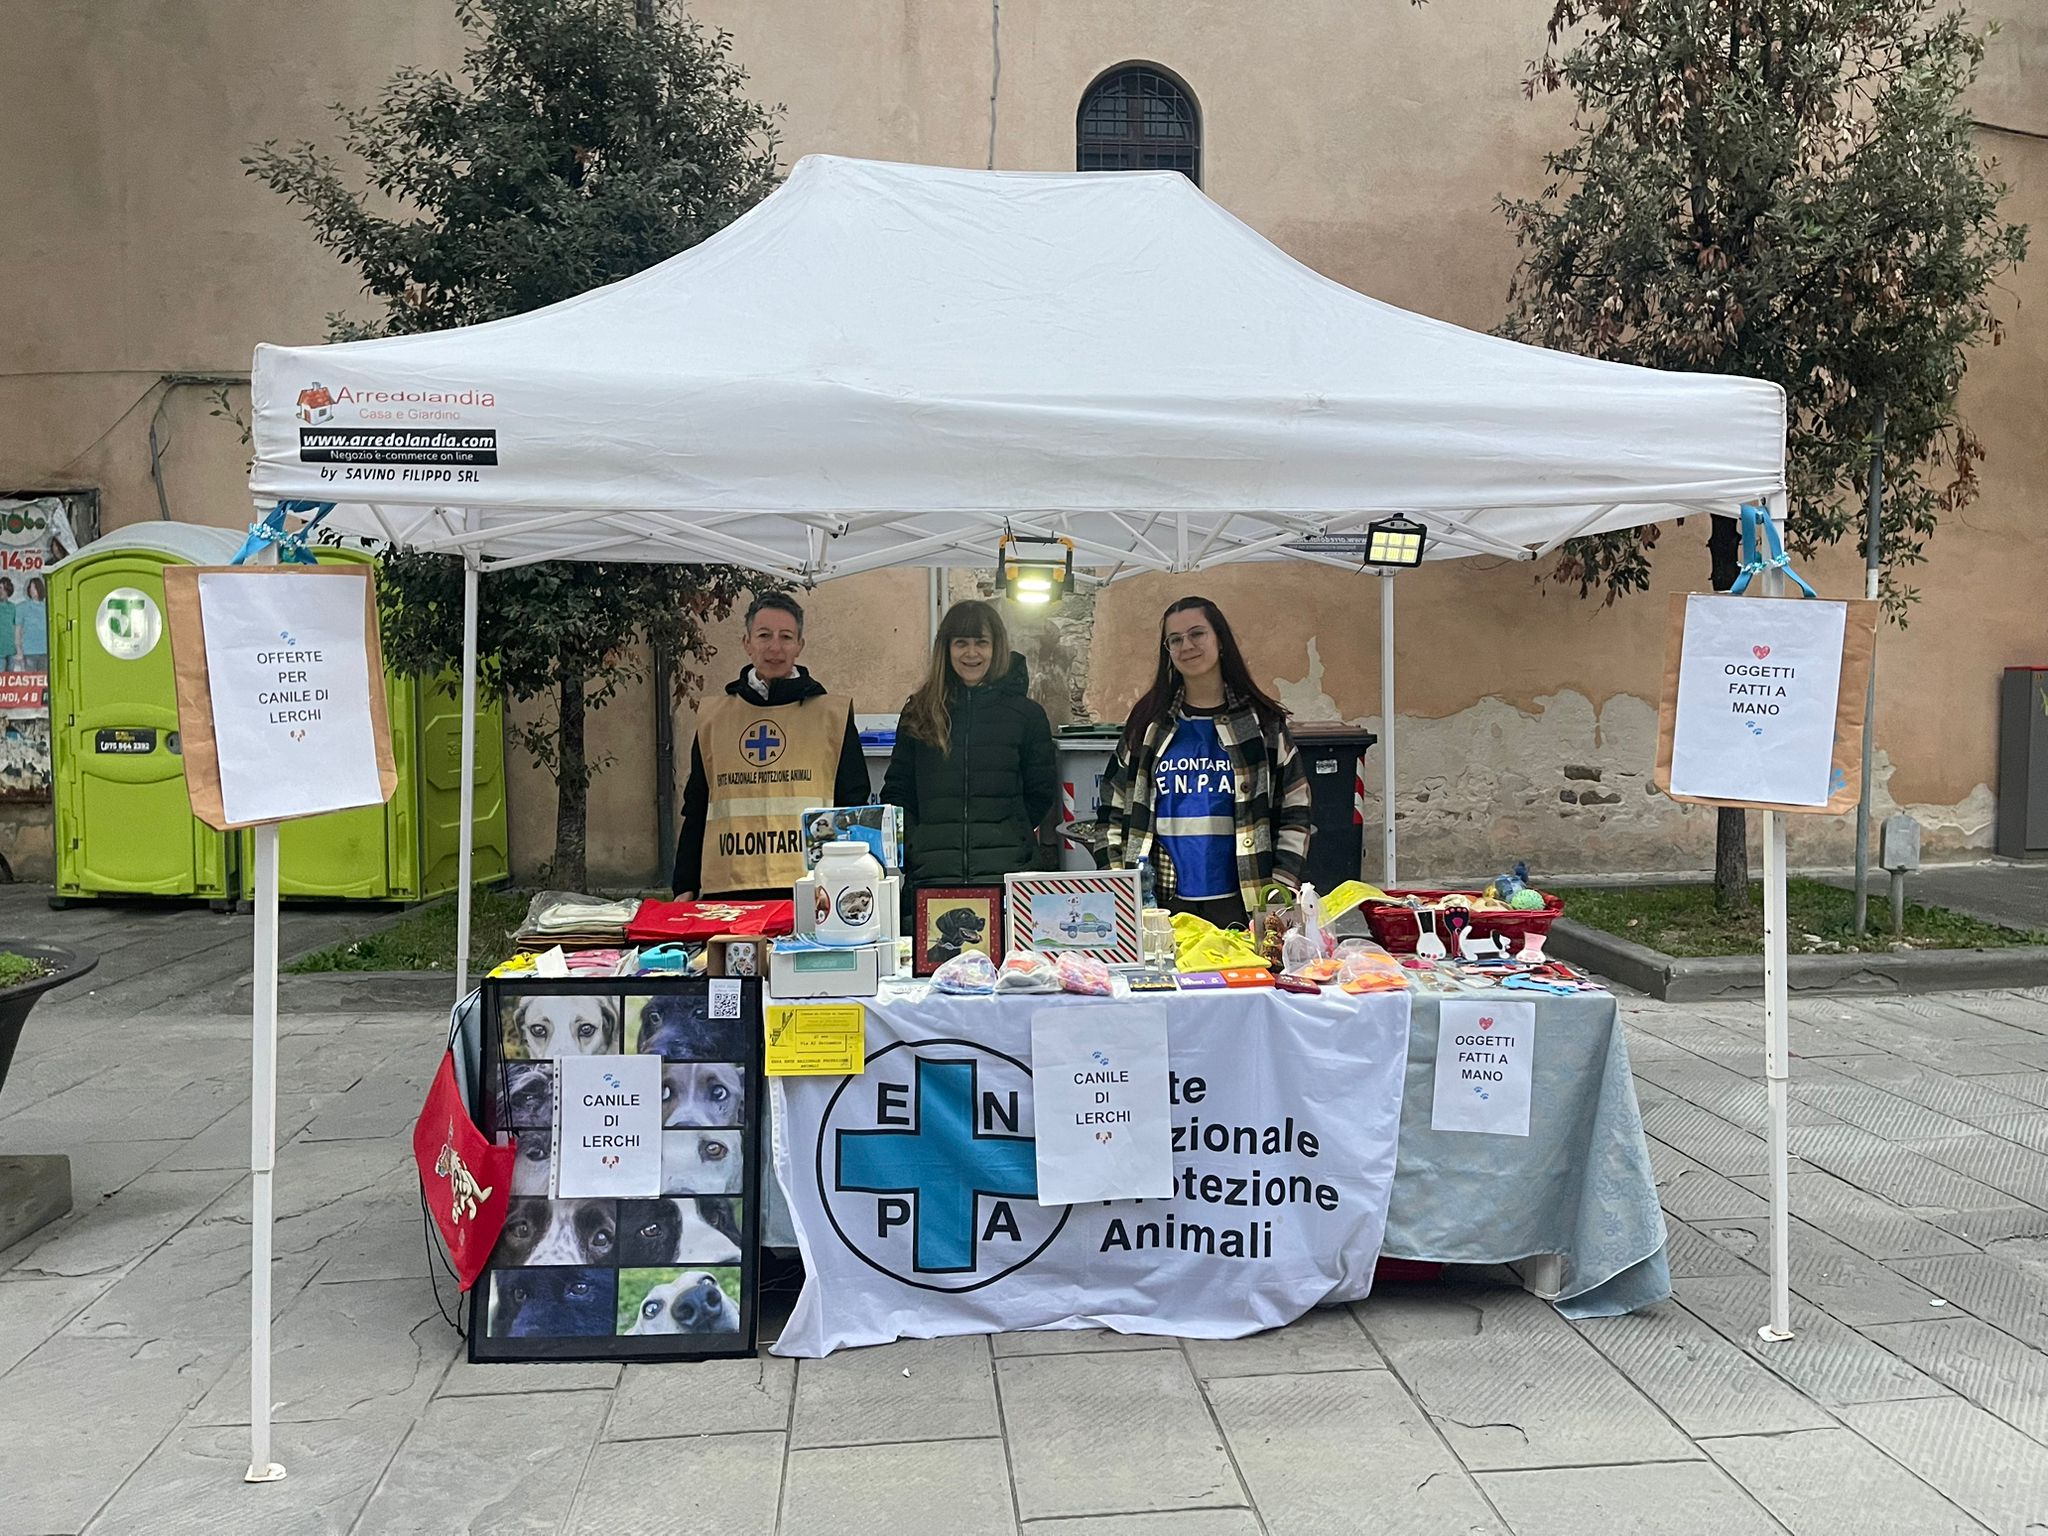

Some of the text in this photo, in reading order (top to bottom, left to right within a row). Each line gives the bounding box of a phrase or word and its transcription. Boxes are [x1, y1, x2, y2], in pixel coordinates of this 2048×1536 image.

[336, 386, 496, 408] Arredolandia
[359, 408, 461, 421] Casa e Giardino
[303, 432, 495, 449] www.arredolandia.com
[330, 450, 474, 462] Negozio e-commerce on line
[320, 466, 480, 483] by SAVINO FILIPPO SRL
[257, 651, 323, 664] OFFERTE
[278, 671, 308, 683] PER
[1724, 664, 1795, 679] OGGETTI
[258, 689, 329, 705] CANILE DI
[1728, 683, 1786, 697] FATTI A
[269, 709, 321, 724] LERCHI
[1732, 702, 1780, 716] MANO
[1155, 758, 1234, 774] OLONTARI
[727, 771, 757, 785] NAZIONALE
[757, 769, 790, 784] PROTEZIONE
[790, 768, 812, 781] ANIMALI
[1455, 1036, 1515, 1047] OGGETTI
[1458, 1052, 1508, 1065] FATTI A
[1073, 1070, 1129, 1085] CANILE
[1461, 1069, 1503, 1082] MANO
[1169, 1071, 1207, 1105] te
[583, 1094, 640, 1107] CANILE
[1095, 1092, 1110, 1104] DI
[877, 1082, 1019, 1133] E N
[604, 1115, 618, 1127] DI
[1075, 1110, 1131, 1126] LERCHI
[583, 1135, 639, 1148] LERCHI
[1171, 1116, 1320, 1158] zionale
[1103, 1167, 1339, 1211] tezione
[878, 1198, 1022, 1241] P A
[1100, 1213, 1272, 1259] Animali
